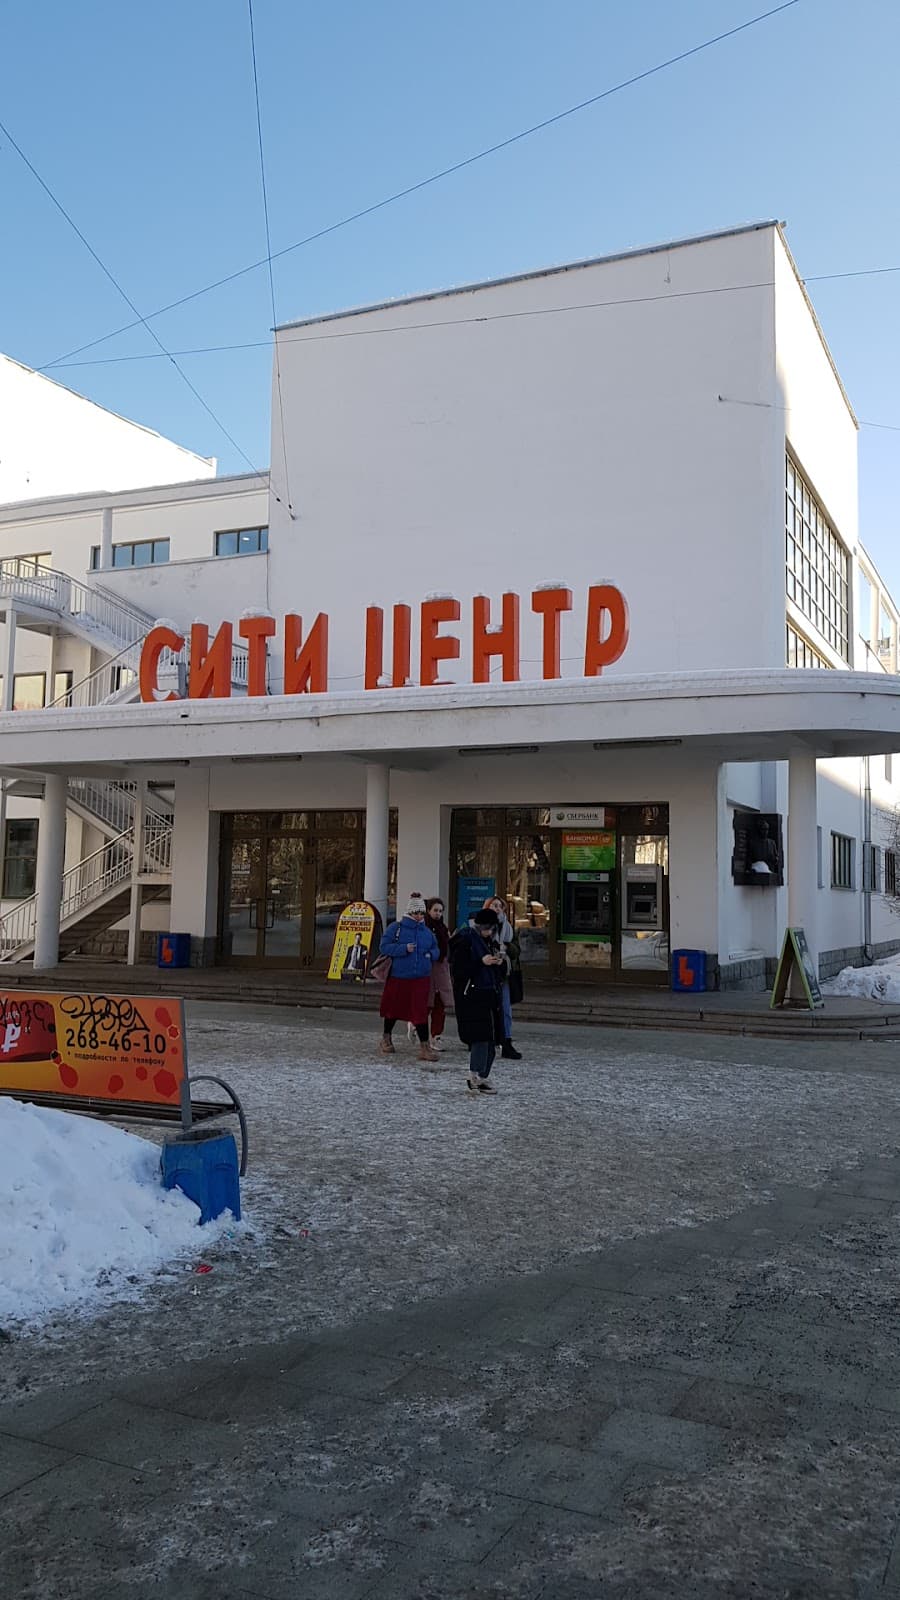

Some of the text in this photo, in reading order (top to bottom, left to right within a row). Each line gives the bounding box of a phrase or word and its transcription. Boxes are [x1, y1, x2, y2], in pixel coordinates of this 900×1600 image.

[140, 584, 629, 703] СИТИ ЦЕНТР
[66, 1028, 166, 1054] 268-46-10
